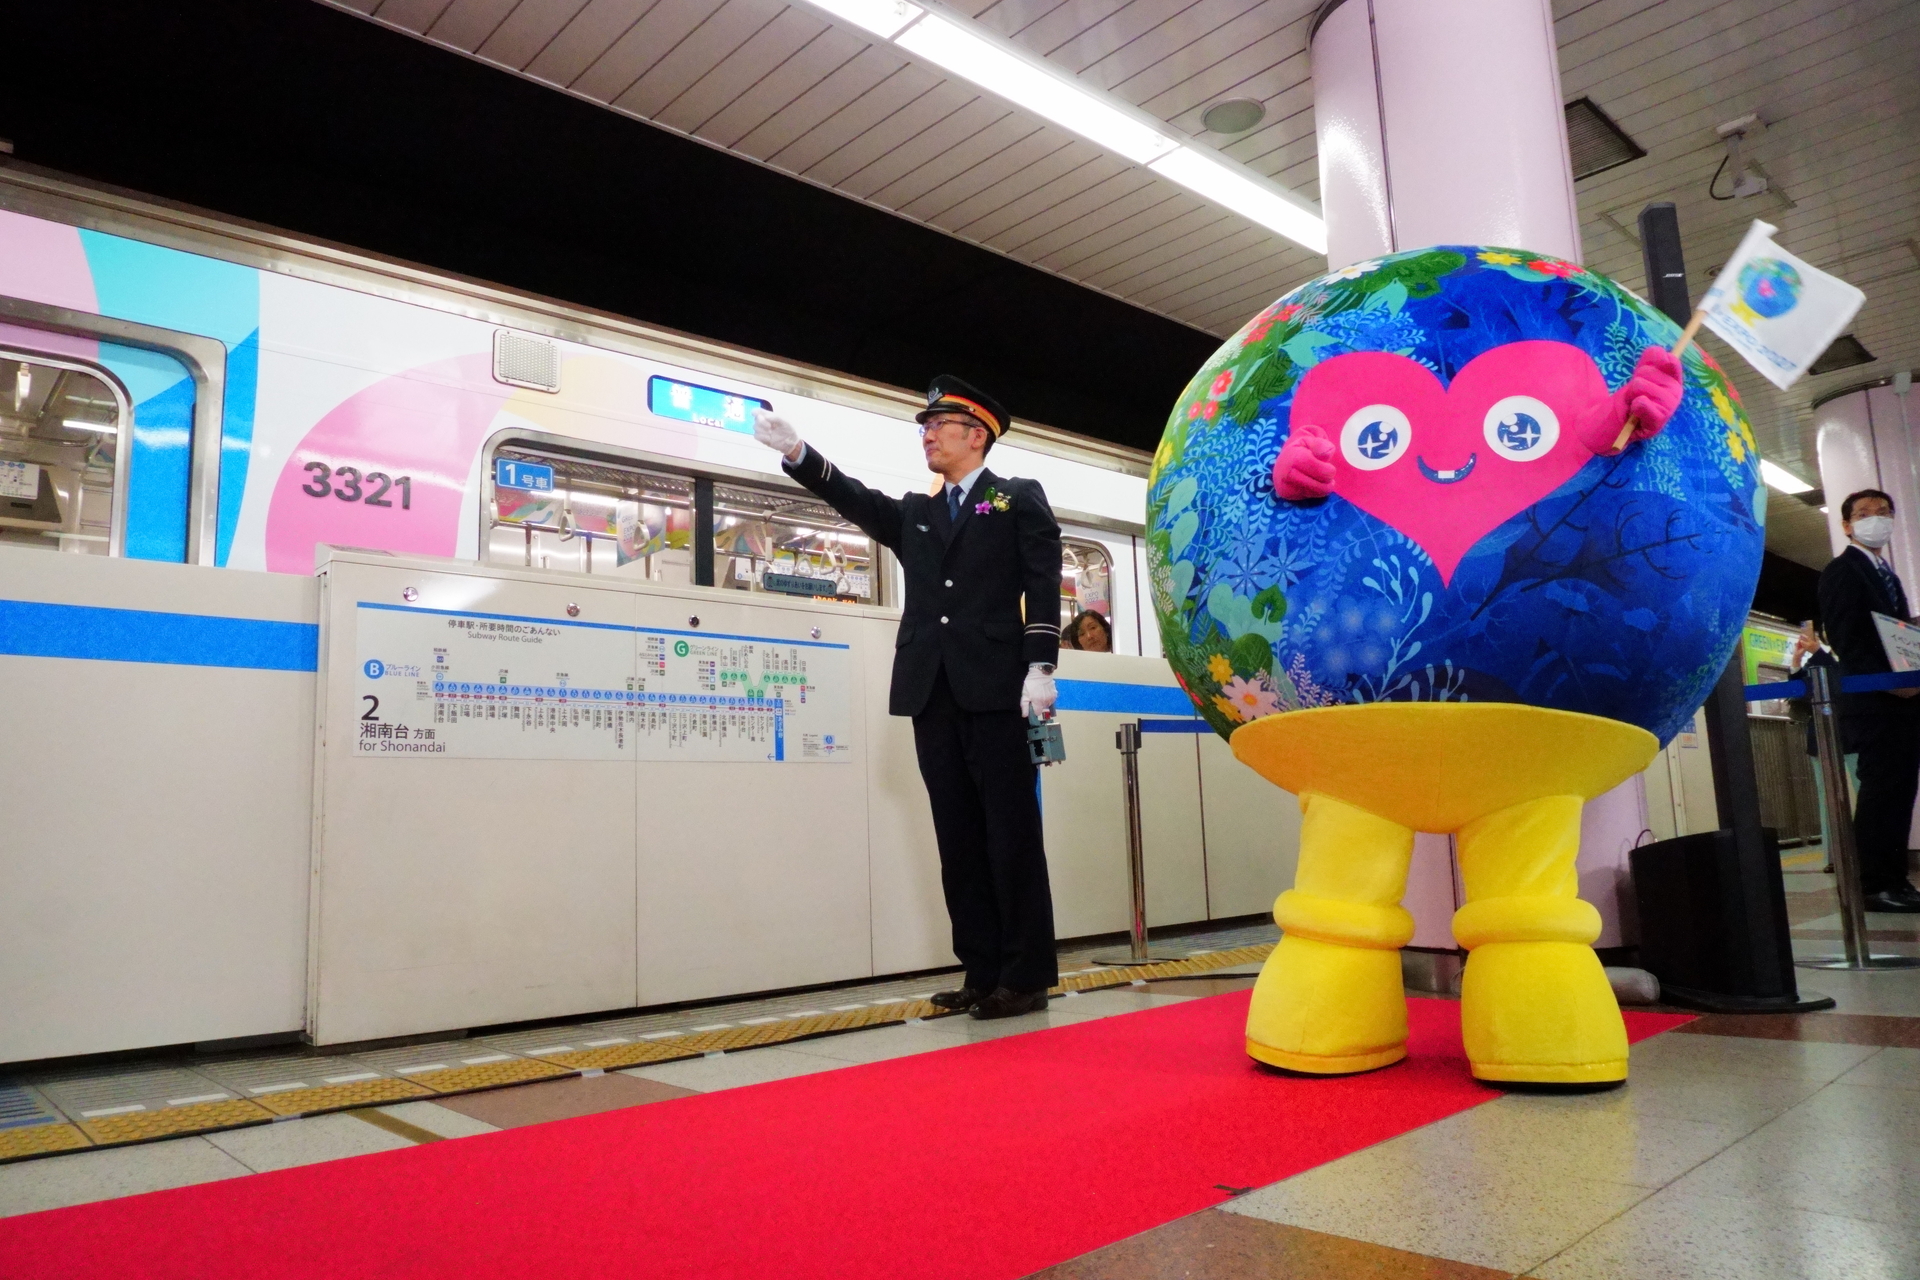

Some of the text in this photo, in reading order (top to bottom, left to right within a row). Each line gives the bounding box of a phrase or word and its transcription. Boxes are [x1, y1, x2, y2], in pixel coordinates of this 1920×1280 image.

[302, 461, 411, 511] 3321
[505, 462, 548, 490] 1号車
[468, 631, 542, 644] Subway Route Guide
[361, 694, 379, 721] 2
[360, 722, 435, 740] 湘南台 方面
[359, 740, 446, 752] for Shonandai
